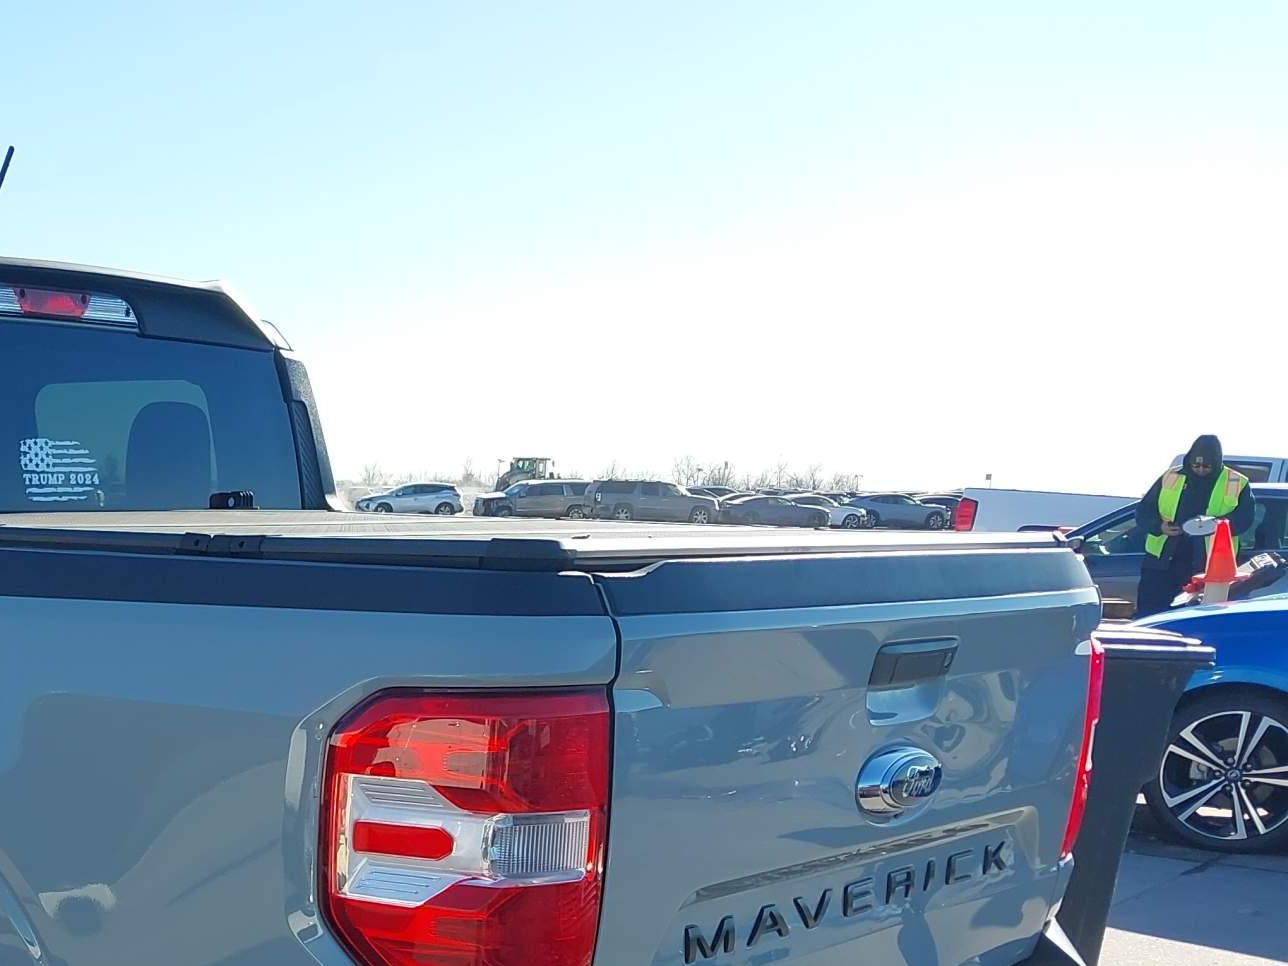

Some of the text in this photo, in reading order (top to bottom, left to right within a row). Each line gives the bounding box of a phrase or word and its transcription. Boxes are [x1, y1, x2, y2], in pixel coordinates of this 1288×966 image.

[23, 473, 99, 485] TRUMP 2024
[684, 841, 1008, 965] MAVERICK
